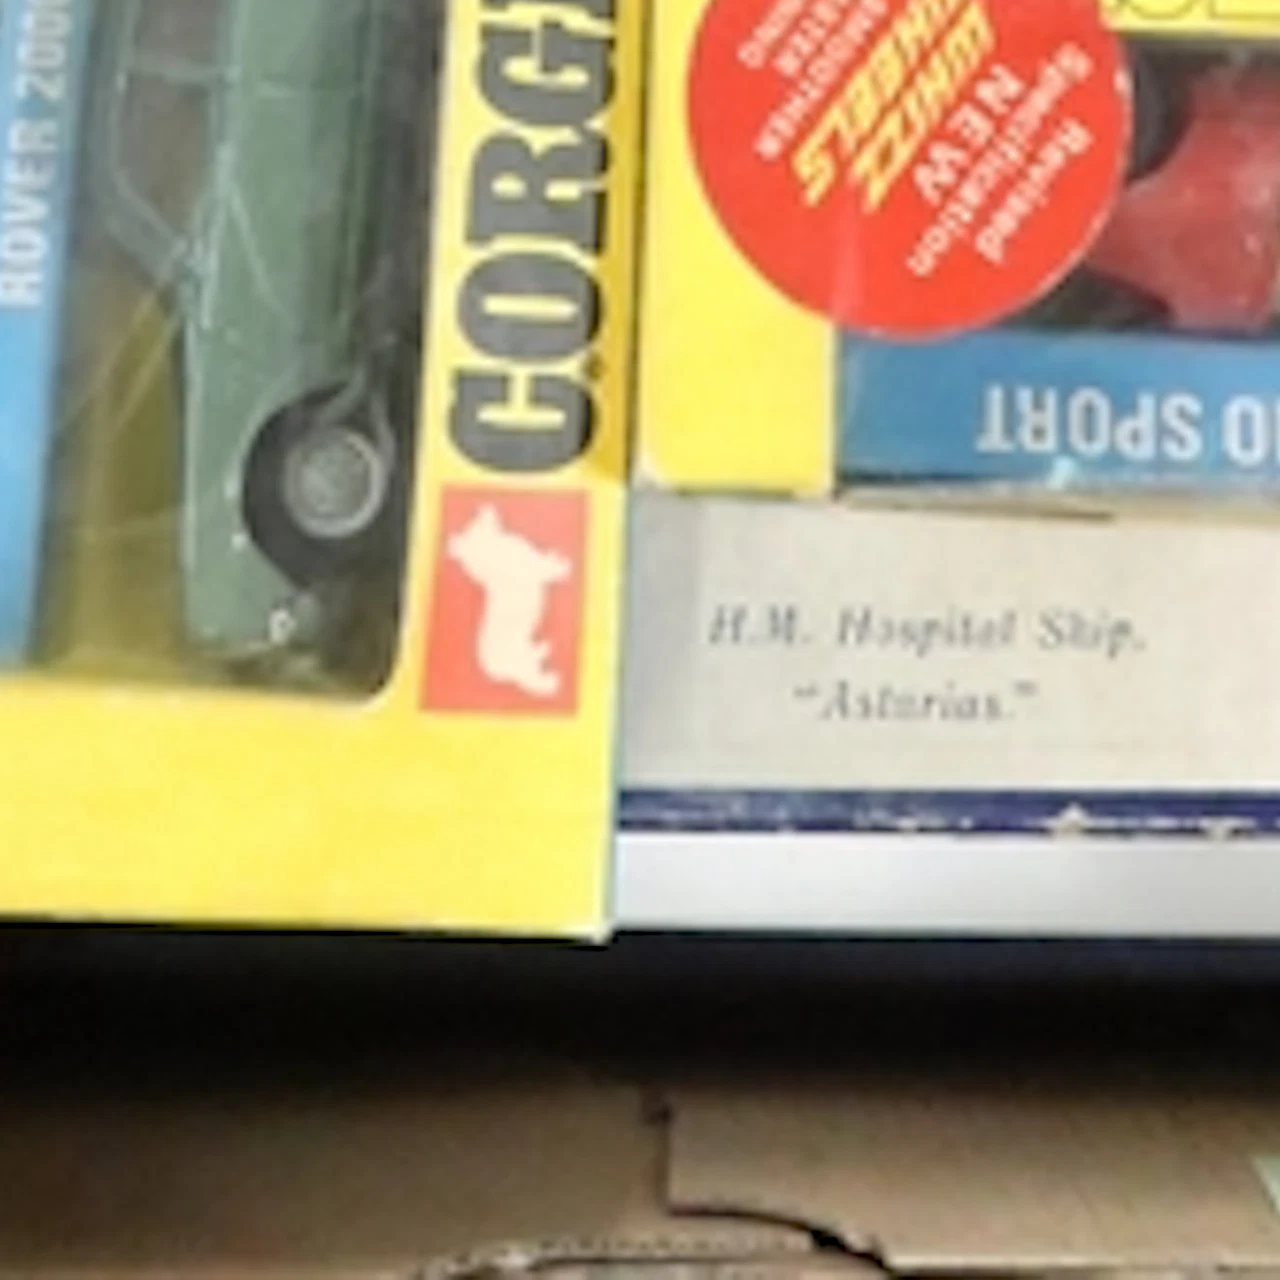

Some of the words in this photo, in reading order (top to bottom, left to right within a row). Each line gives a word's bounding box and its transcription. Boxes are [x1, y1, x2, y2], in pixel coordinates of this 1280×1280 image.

[906, 41, 1094, 278] Specification
[913, 63, 1026, 206] NEW
[975, 116, 1096, 266] Revised
[976, 384, 1203, 465] SPORT
[837, 604, 1019, 660] Hospital
